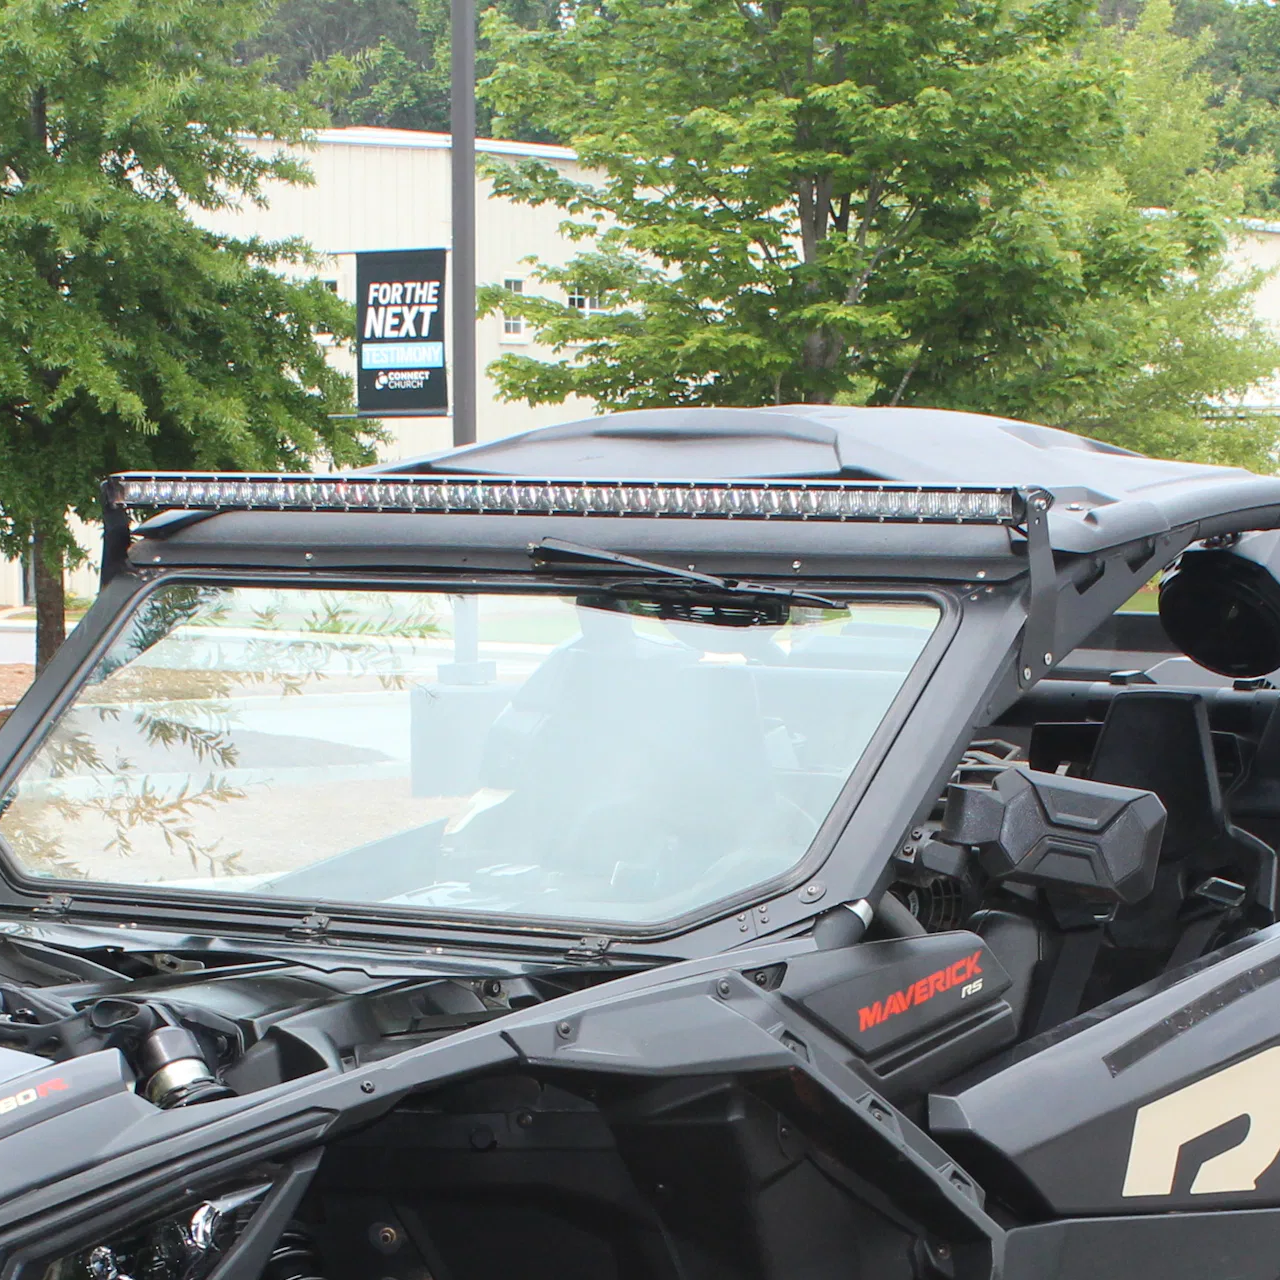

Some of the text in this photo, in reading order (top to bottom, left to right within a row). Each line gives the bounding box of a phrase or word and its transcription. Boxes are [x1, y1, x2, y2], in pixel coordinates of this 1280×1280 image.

[368, 281, 440, 305] FOR THE
[364, 305, 438, 338] NEXT
[363, 346, 441, 365] TESTIMONY
[388, 371, 430, 381] CONNECT
[388, 380, 423, 389] CHURCH
[857, 950, 984, 1032] MAVERICK
[961, 977, 983, 998] RS
